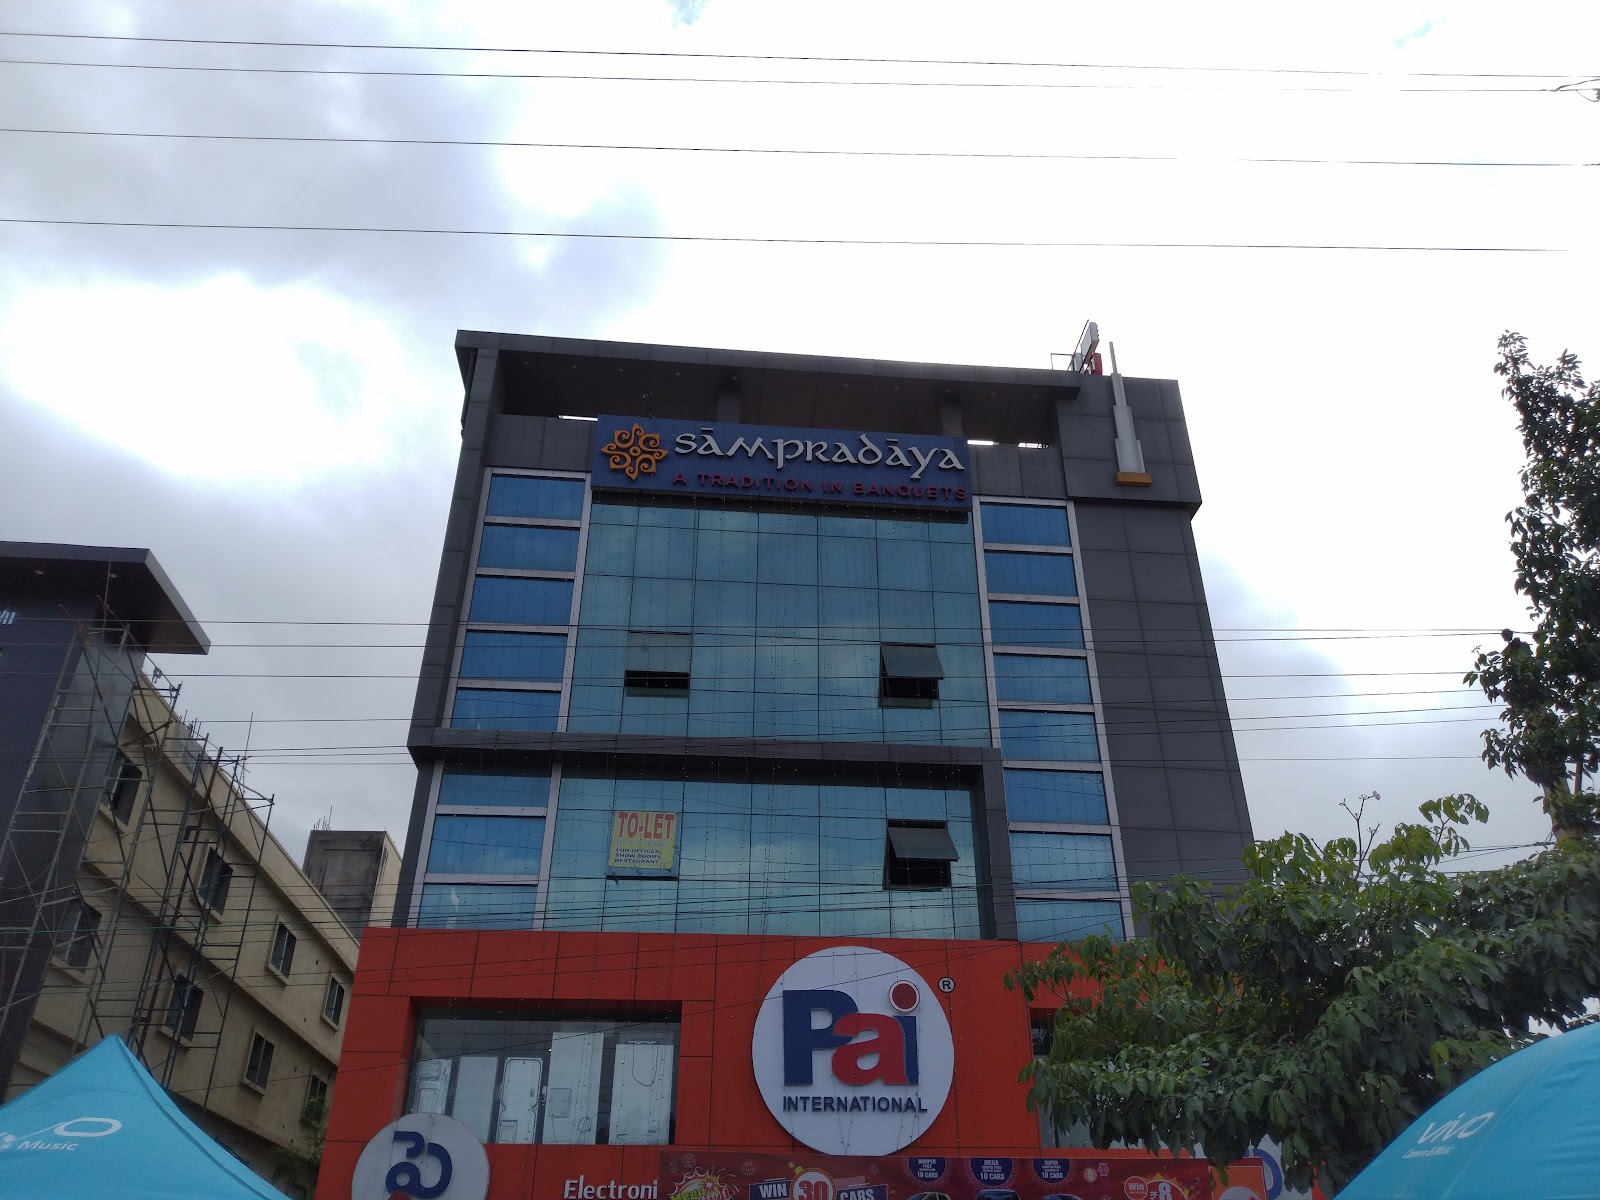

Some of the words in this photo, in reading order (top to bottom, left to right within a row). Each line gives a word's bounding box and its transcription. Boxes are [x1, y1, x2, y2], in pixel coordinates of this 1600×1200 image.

[673, 472, 687, 485] A
[698, 472, 813, 492] TRADITION
[823, 480, 843, 493] IN
[854, 482, 967, 500] BANQUETS
[618, 811, 675, 839] TO-LET
[782, 979, 919, 1086] Pai
[782, 1095, 928, 1113] INTERNATIONAL
[1417, 1111, 1495, 1145] vivo
[17, 1140, 79, 1151] Music
[924, 1171, 939, 1179] CARS
[980, 1172, 988, 1180] 10
[758, 1183, 788, 1199] WIN
[798, 1180, 828, 1200] 30
[839, 1188, 875, 1200] CARS
[1128, 1182, 1145, 1191] Win
